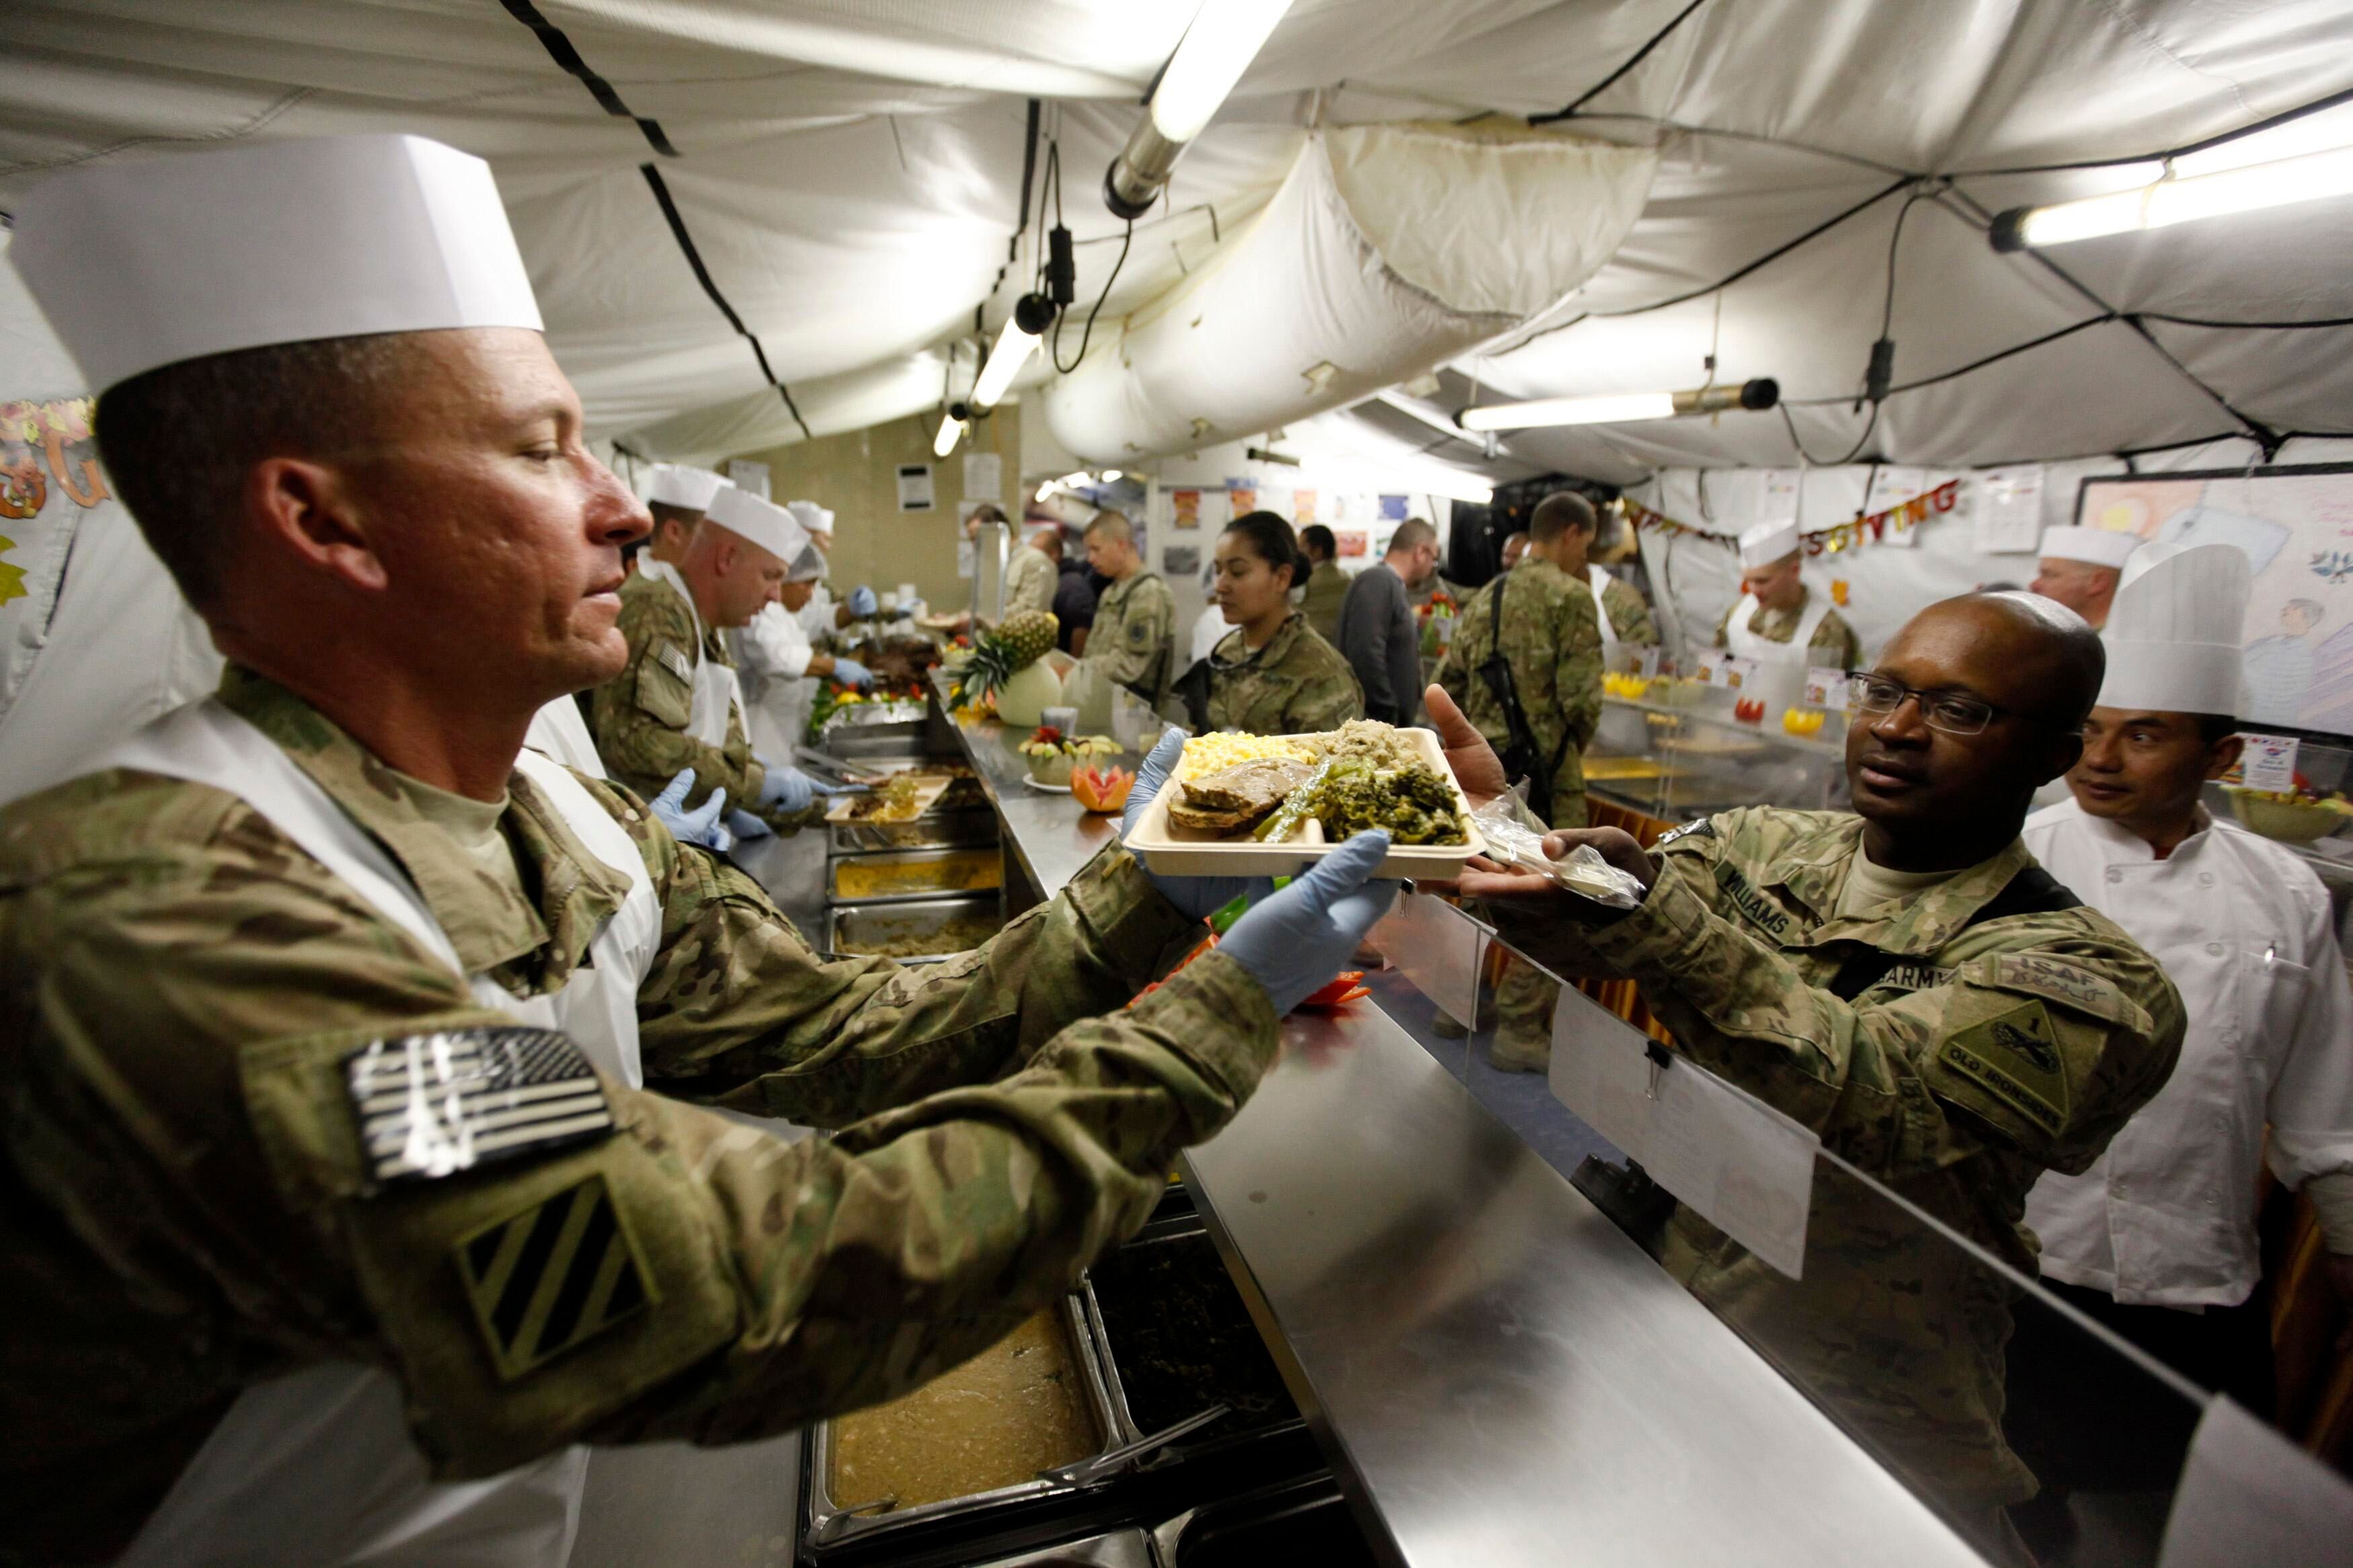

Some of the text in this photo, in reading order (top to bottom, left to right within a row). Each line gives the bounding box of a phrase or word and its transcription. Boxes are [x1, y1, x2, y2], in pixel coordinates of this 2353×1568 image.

[1725, 870, 1790, 934] WILLIAMS
[2020, 957, 2096, 986] ISAF
[2028, 1017, 2040, 1034] 1
[1950, 1048, 2062, 1129] OLD IRONSIDES
